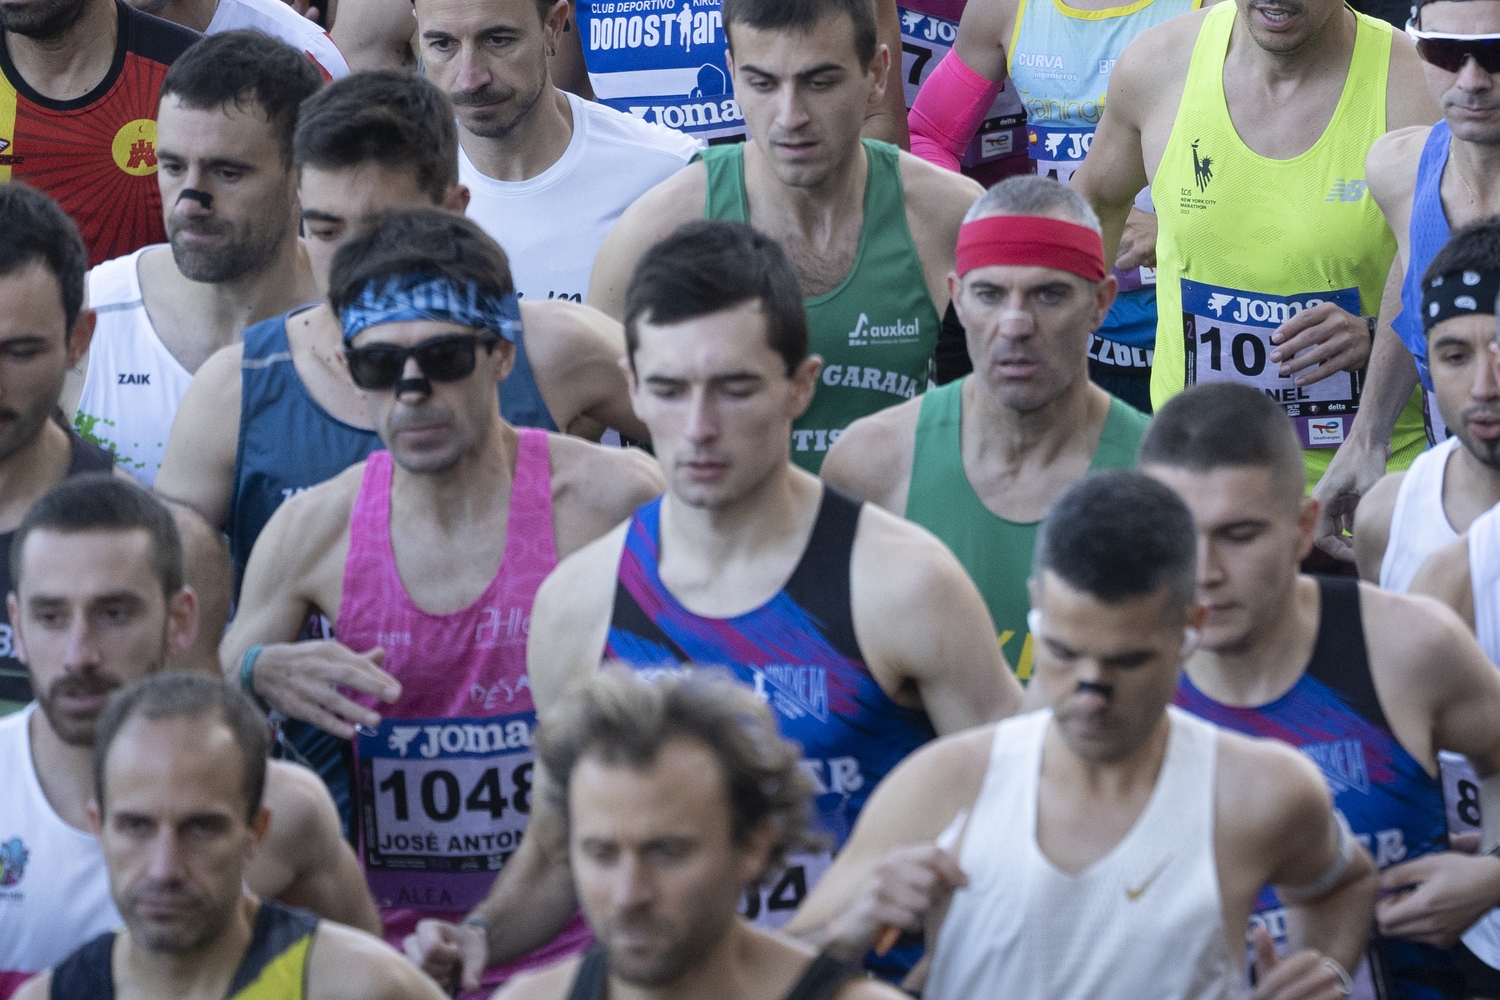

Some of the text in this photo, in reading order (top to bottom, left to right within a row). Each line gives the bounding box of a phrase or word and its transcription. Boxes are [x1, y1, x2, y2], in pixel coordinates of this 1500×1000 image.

[591, 3, 614, 13] CLUB
[617, 0, 675, 12] DEPORTIVO
[1019, 53, 1064, 69] CURVA
[1034, 71, 1078, 81] ingenieros
[870, 318, 919, 337] auxkal
[118, 374, 151, 385] ZAIK
